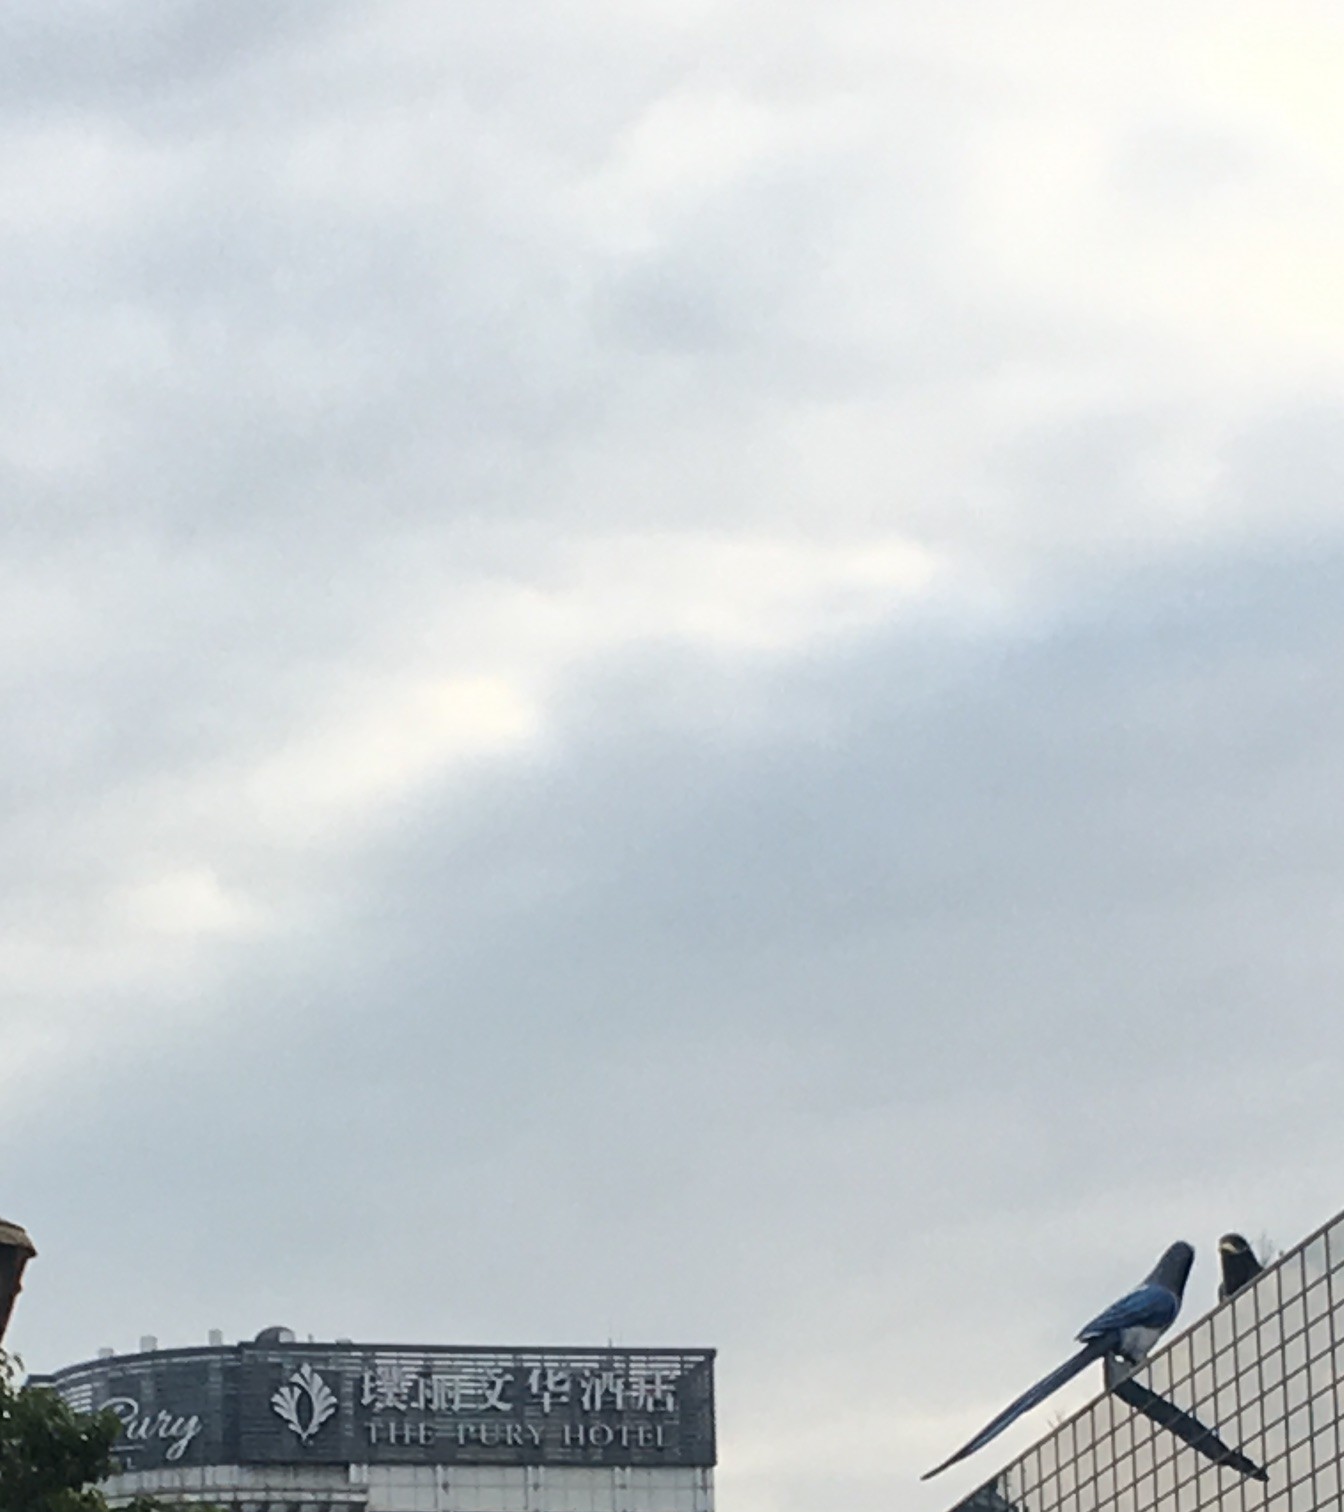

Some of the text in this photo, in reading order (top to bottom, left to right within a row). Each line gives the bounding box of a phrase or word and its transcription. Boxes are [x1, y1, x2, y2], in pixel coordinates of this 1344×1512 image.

[360, 1366, 680, 1413] 璞丽文华酒店
[364, 1421, 672, 1448] THE PURY HOTEL
